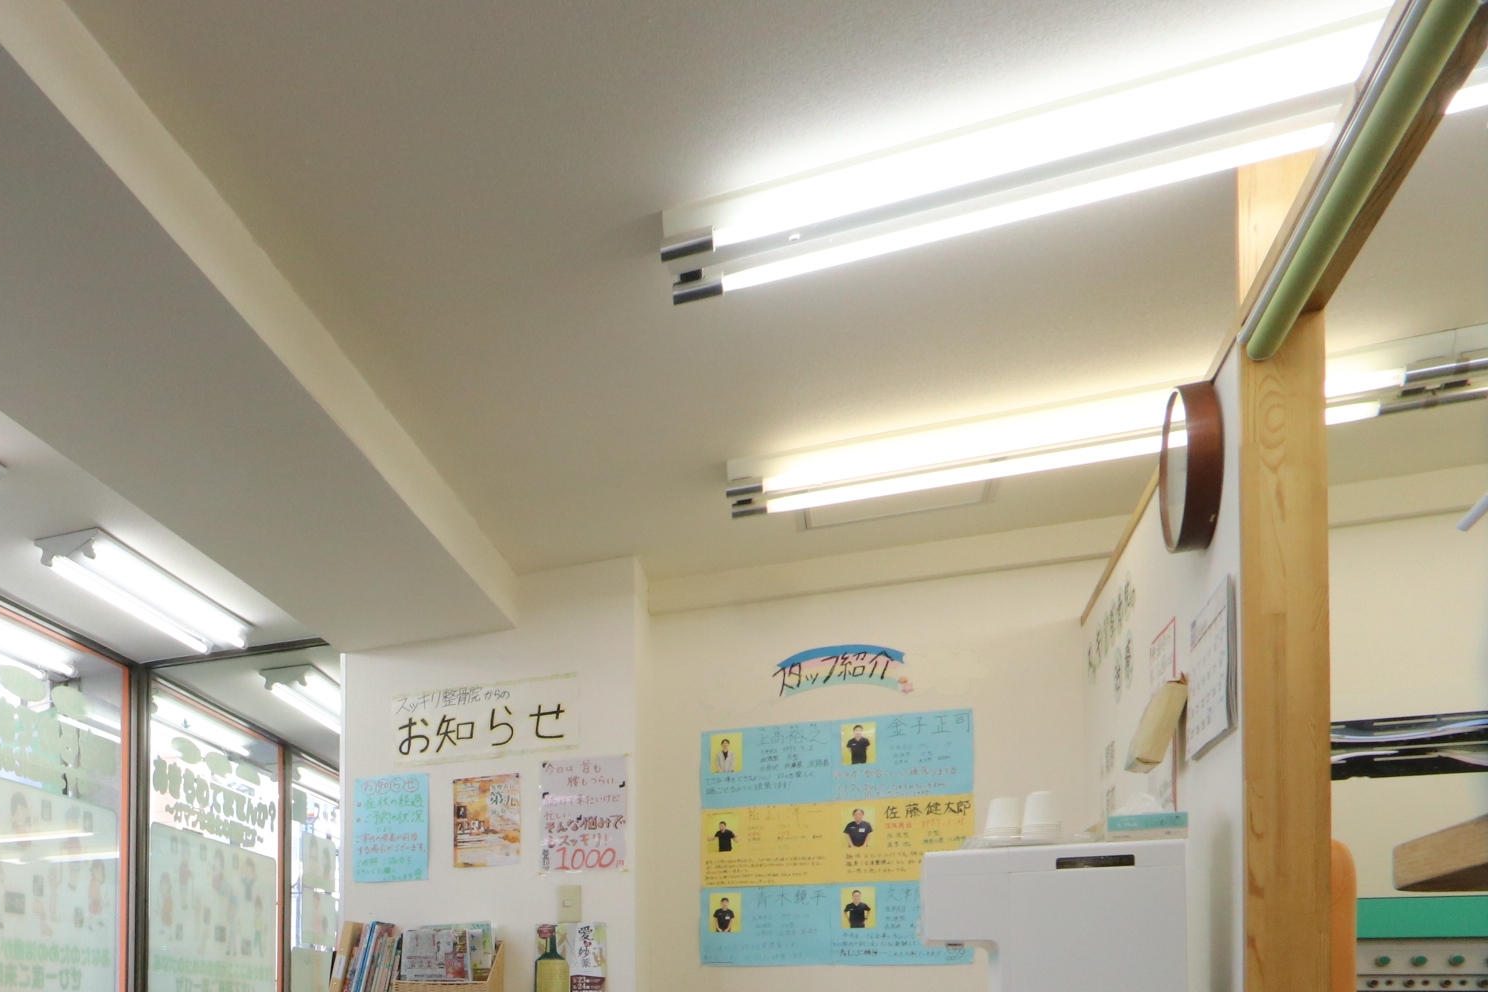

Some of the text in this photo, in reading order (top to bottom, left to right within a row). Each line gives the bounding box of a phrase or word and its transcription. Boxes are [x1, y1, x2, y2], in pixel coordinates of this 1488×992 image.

[772, 650, 894, 697] スタッフ紹介
[395, 685, 511, 715] スッキリ整骨院からの
[398, 703, 565, 755] お知らせ
[886, 713, 971, 739] 金子正司
[362, 778, 418, 794] お知らせ
[884, 800, 971, 819] 佐藤健太郎
[545, 814, 626, 833] そんな悩みで
